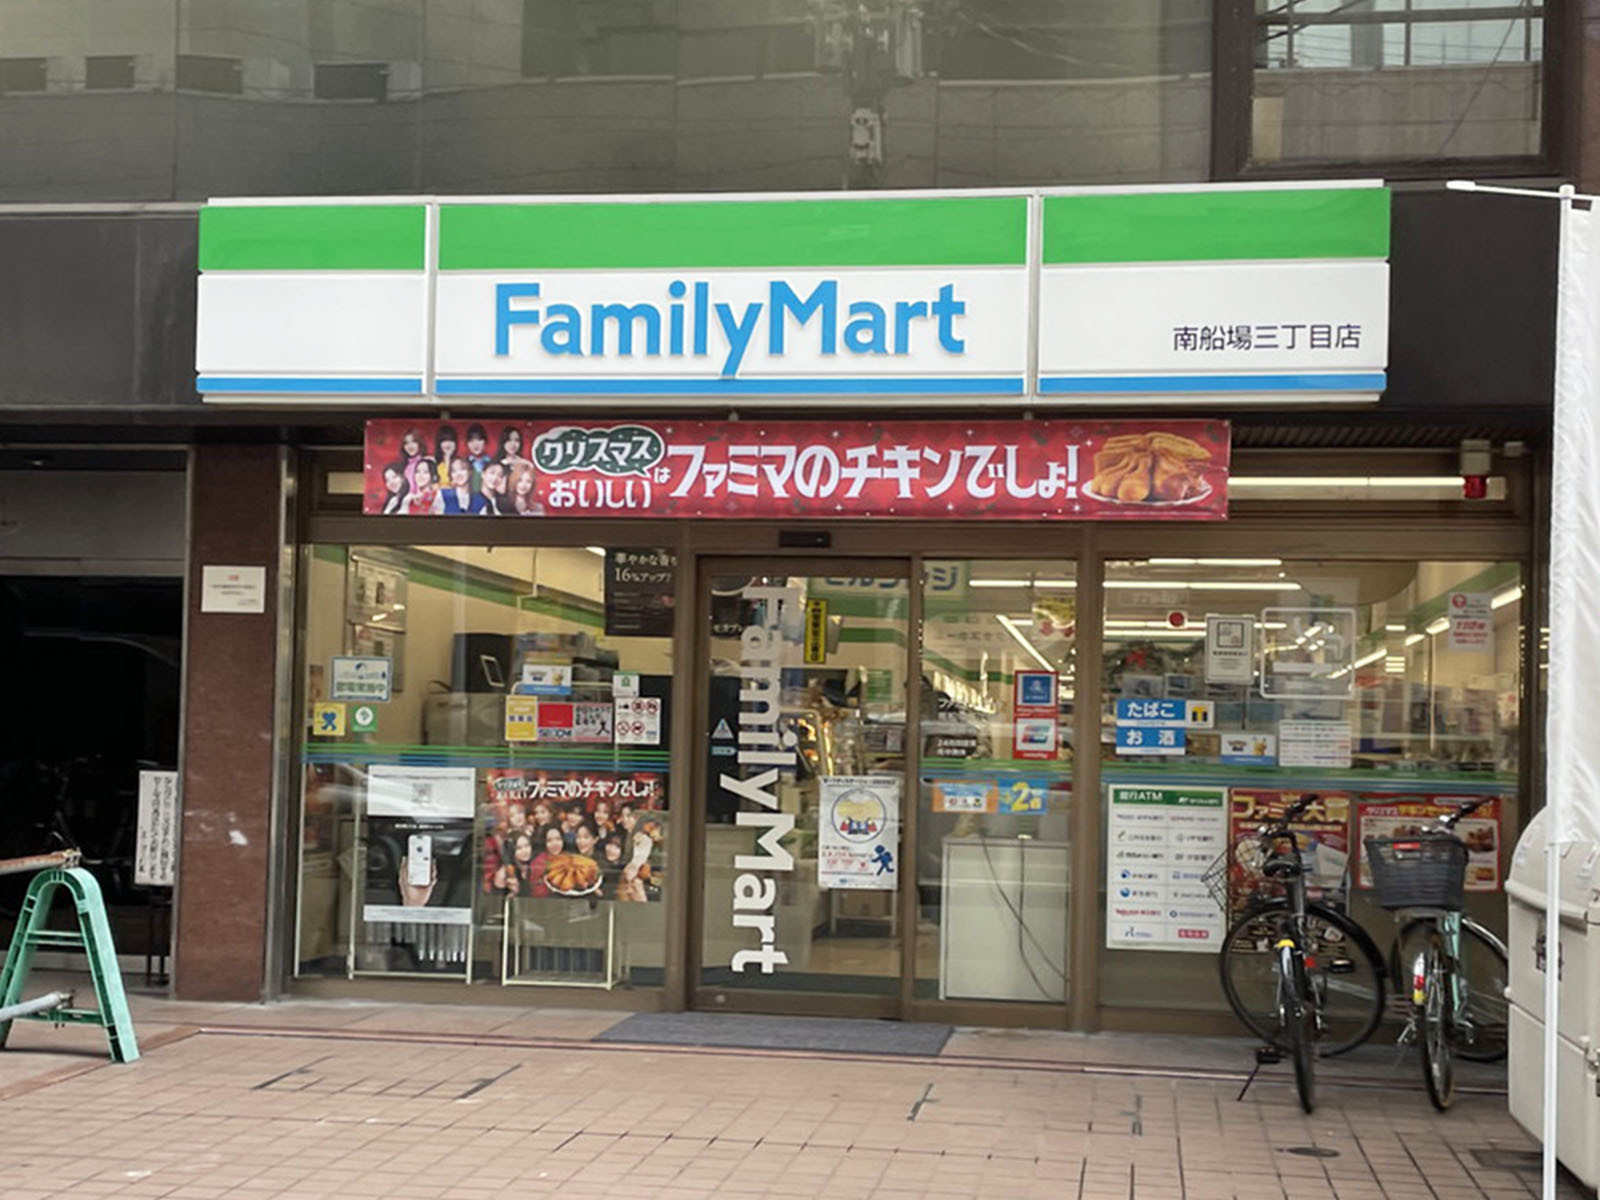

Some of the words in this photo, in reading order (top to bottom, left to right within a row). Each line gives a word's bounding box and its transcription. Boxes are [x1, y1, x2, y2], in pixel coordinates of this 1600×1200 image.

[495, 280, 966, 378] FamilyMart
[1173, 323, 1362, 352] 南船場三丁目店
[543, 436, 653, 466] クリスマス
[1127, 702, 1175, 718] たばこ
[719, 586, 801, 974] FamilyMart
